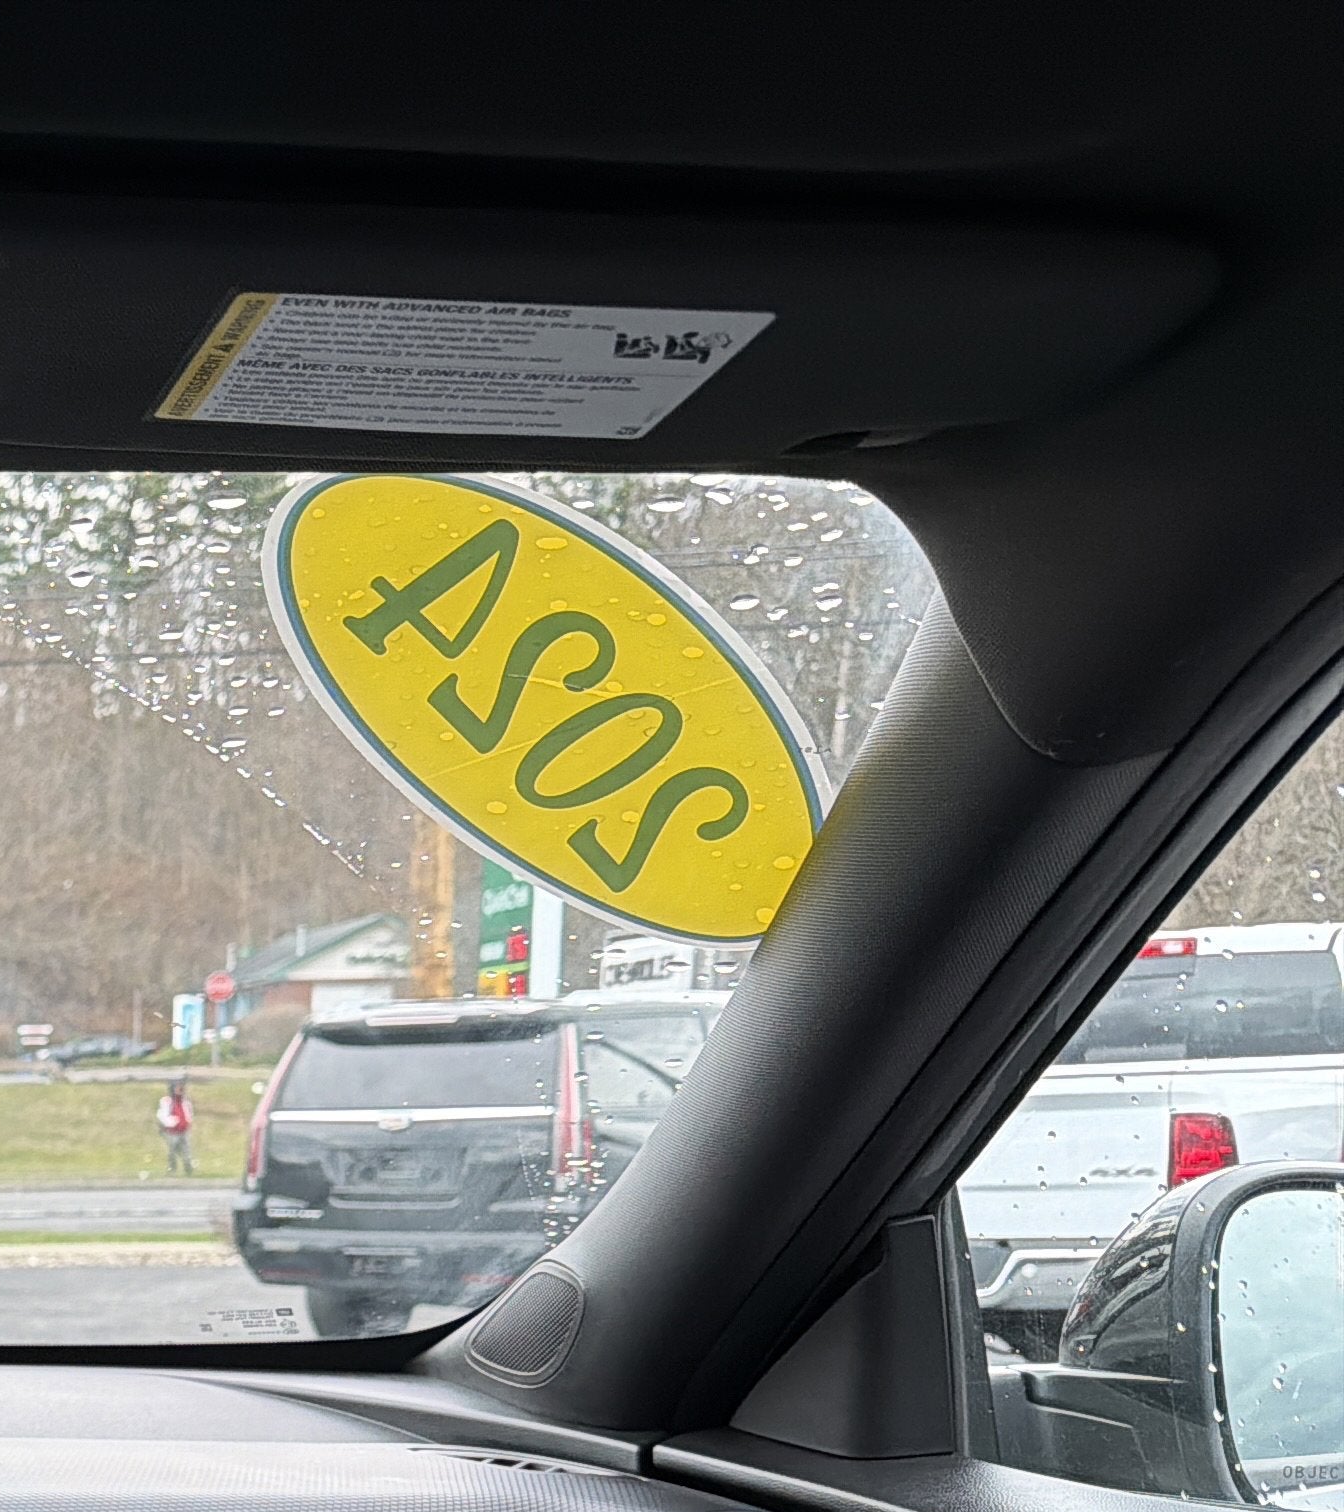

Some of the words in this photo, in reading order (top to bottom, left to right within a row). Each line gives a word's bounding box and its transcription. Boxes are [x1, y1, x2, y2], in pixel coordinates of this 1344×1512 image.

[282, 296, 332, 308] EVEN
[334, 298, 380, 311] WITH
[382, 302, 483, 315] ADVANCED
[485, 305, 518, 316] AIR
[520, 307, 573, 319] BAGS
[237, 357, 286, 370] MÊME
[288, 361, 332, 373] AVEC
[334, 363, 368, 375] DES
[370, 365, 414, 376] SACS
[416, 367, 522, 381] GONFLABLES
[524, 372, 635, 385] INTELLIGENTS
